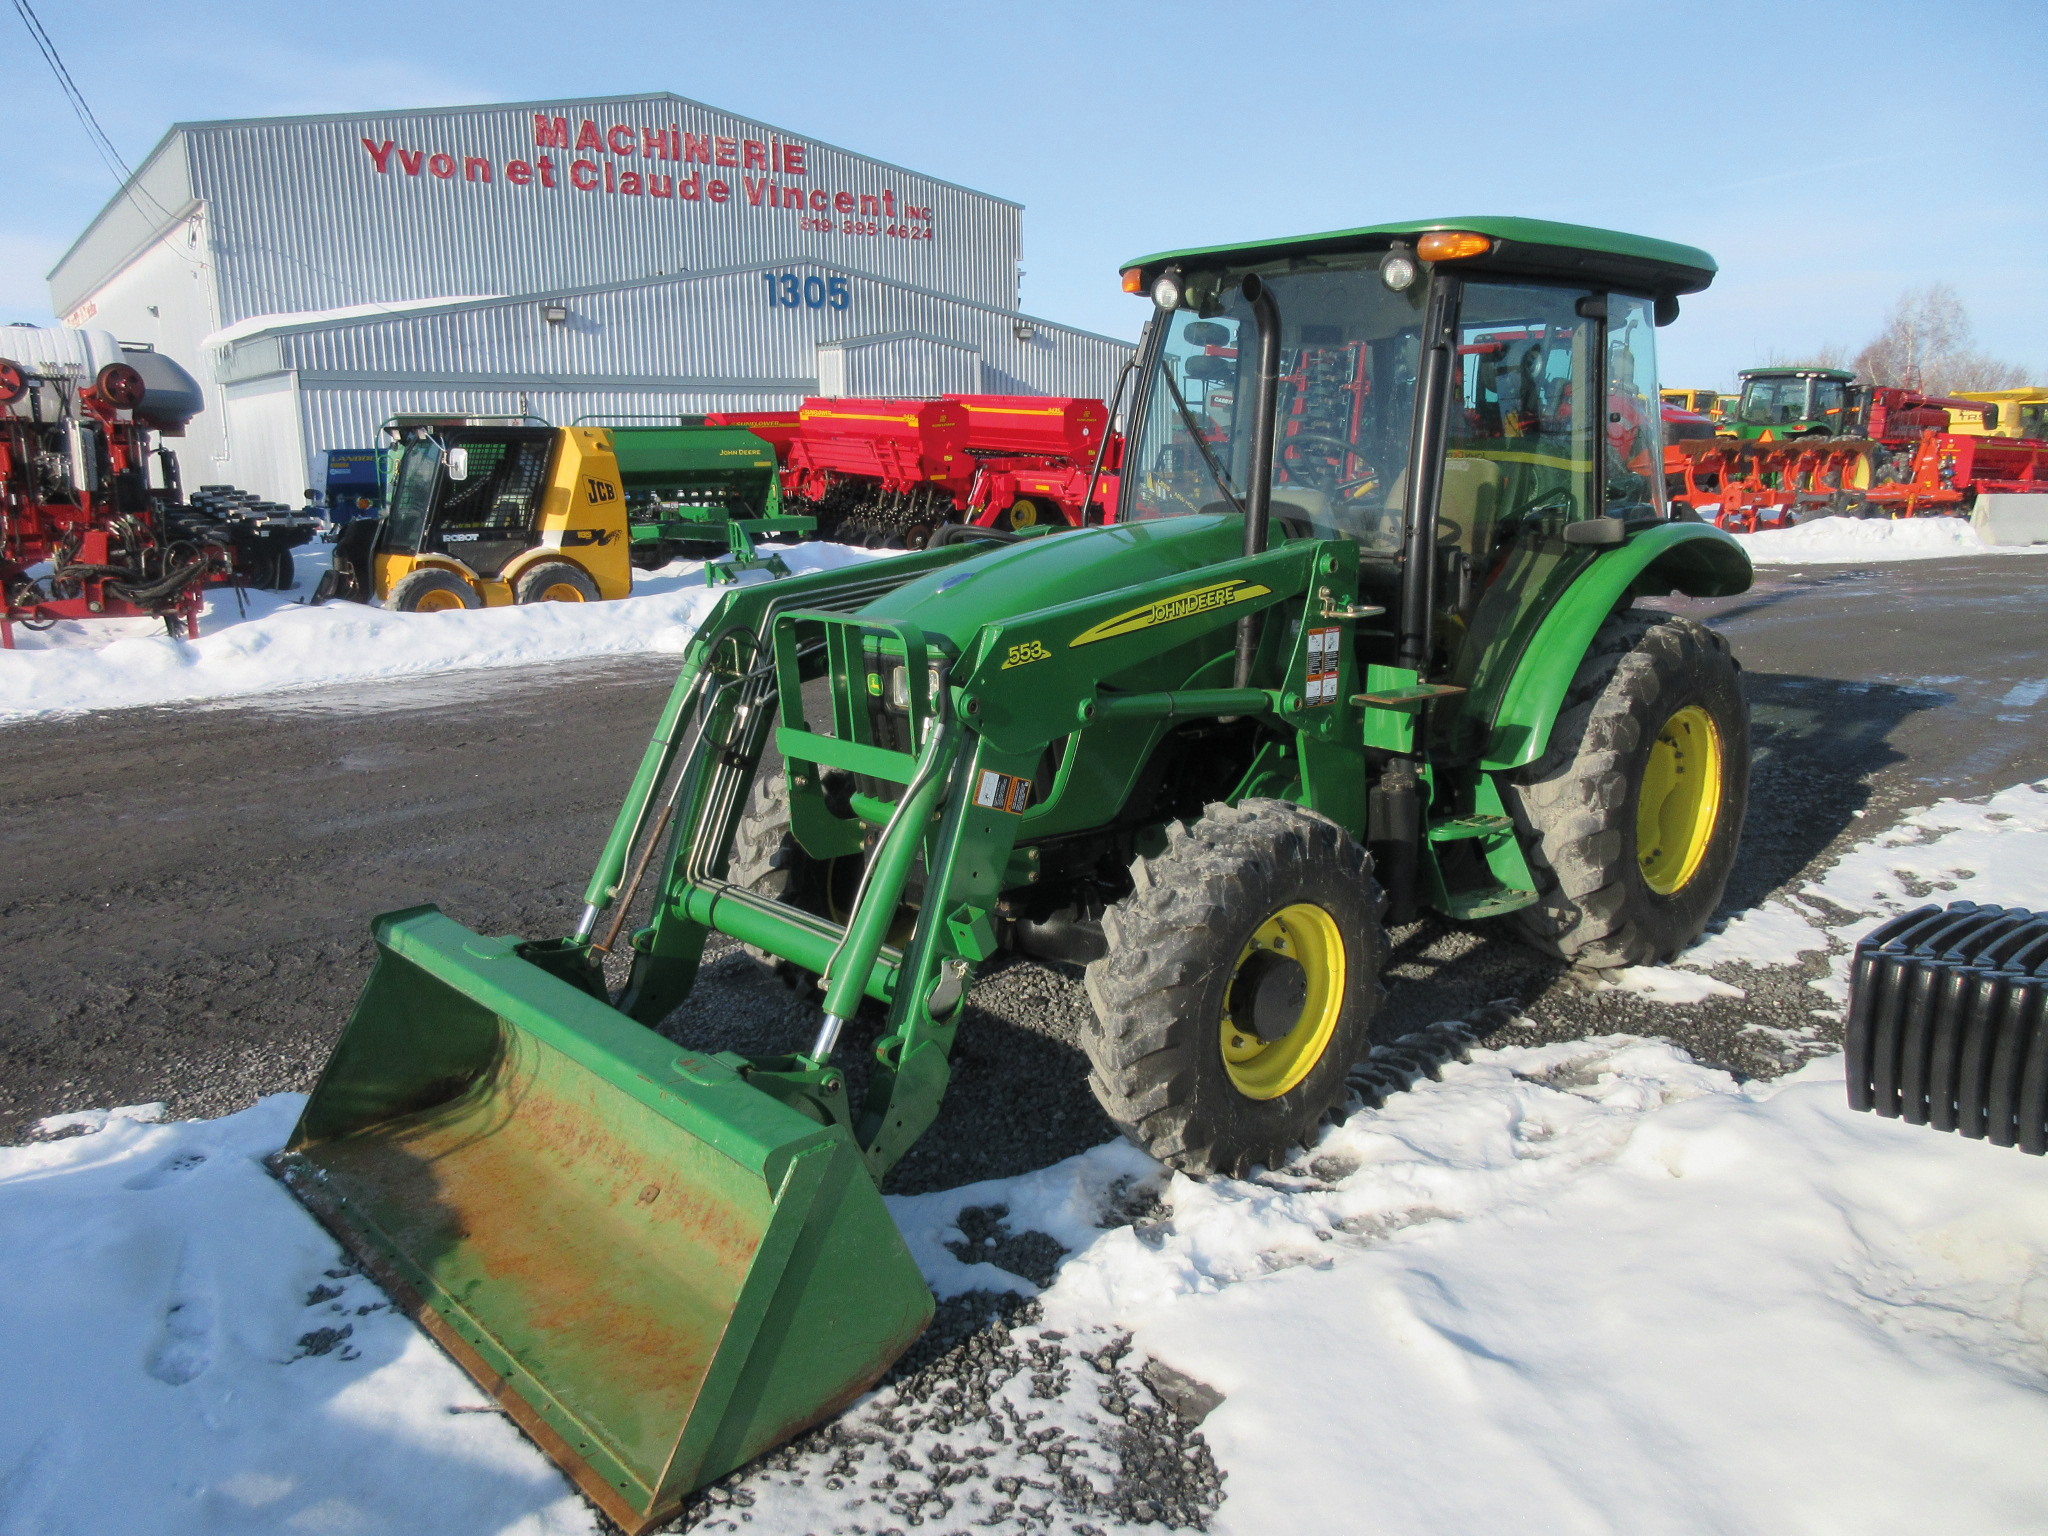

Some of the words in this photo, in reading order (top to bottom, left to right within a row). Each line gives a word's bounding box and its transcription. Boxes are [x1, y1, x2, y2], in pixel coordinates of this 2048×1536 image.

[361, 138, 492, 184] Yvon
[506, 155, 556, 188] et
[570, 158, 730, 203] Claude
[743, 176, 896, 218] Vincent
[764, 273, 850, 310] 1305
[588, 479, 615, 504] JCB
[442, 533, 480, 542] ROBOT
[1147, 599, 1186, 624] JOHN
[1187, 586, 1234, 612] DEERE
[1008, 640, 1043, 665] 553
